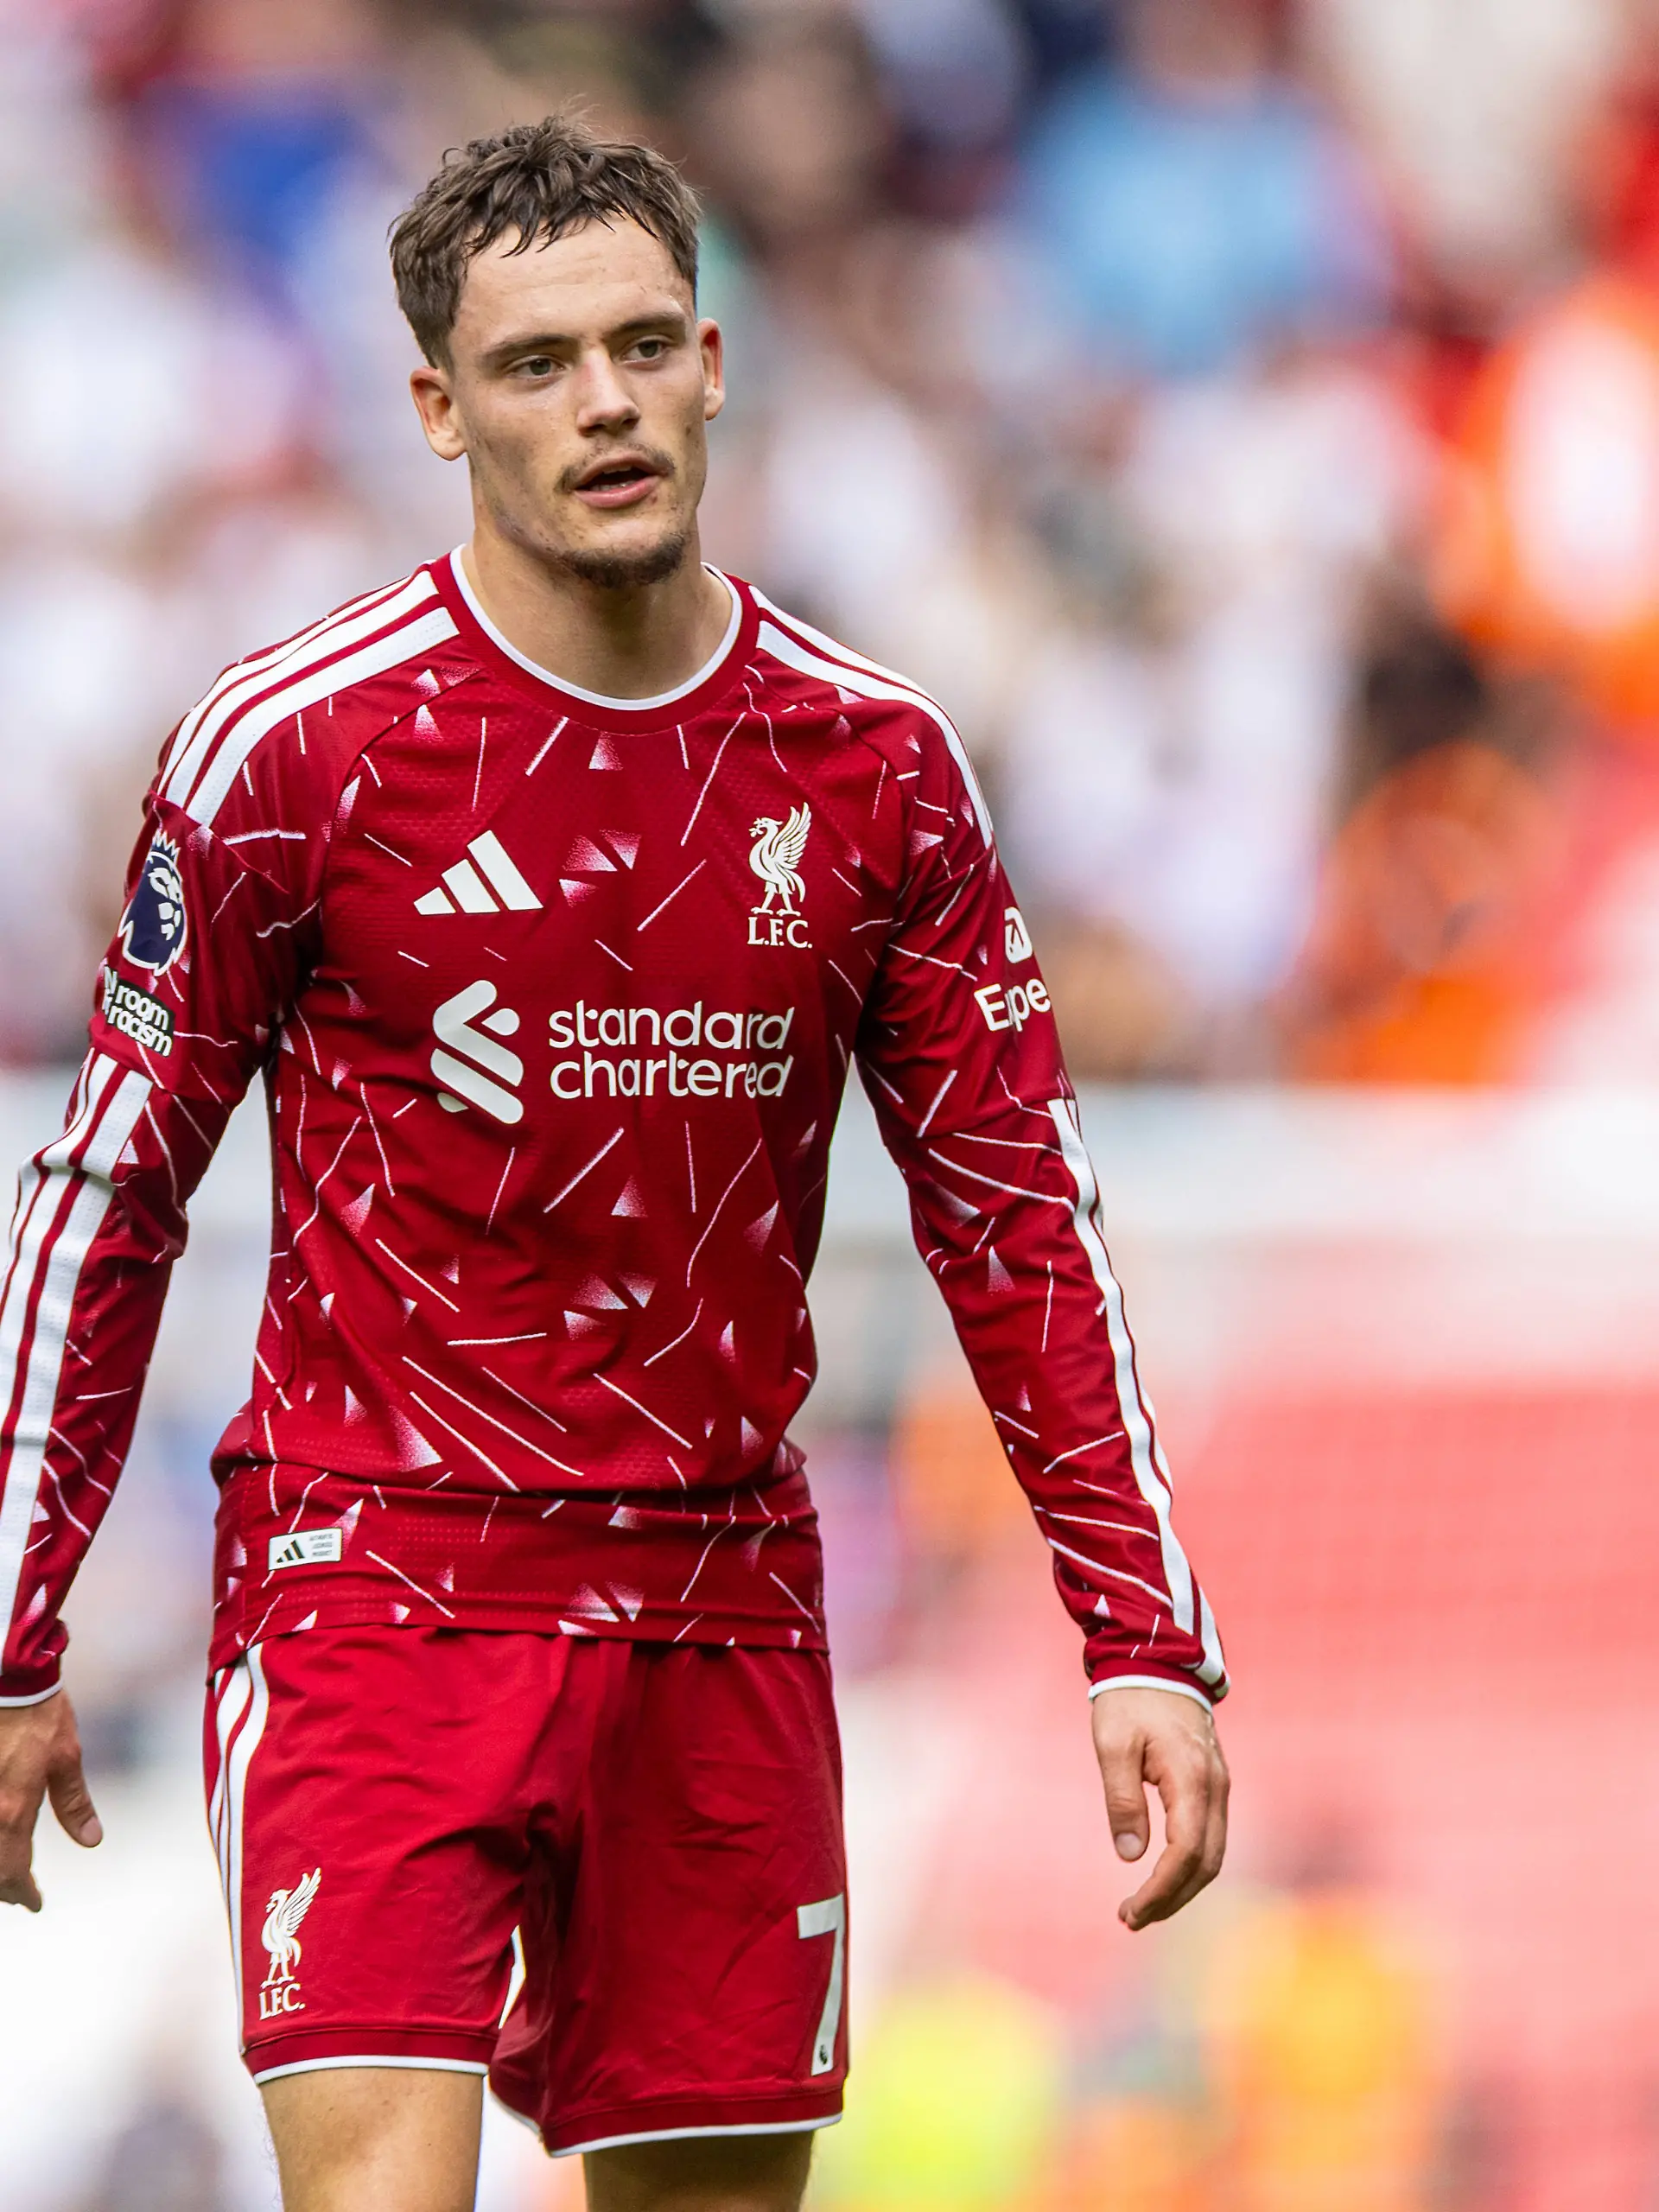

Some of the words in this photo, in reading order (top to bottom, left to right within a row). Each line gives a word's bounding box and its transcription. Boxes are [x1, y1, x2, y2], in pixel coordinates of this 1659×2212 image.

[747, 917, 813, 949] L.F.C.
[107, 1006, 172, 1057] racism
[115, 985, 168, 1030] room
[548, 1000, 795, 1049] standard
[550, 1050, 794, 1098] chartered
[797, 1891, 845, 2076] 7
